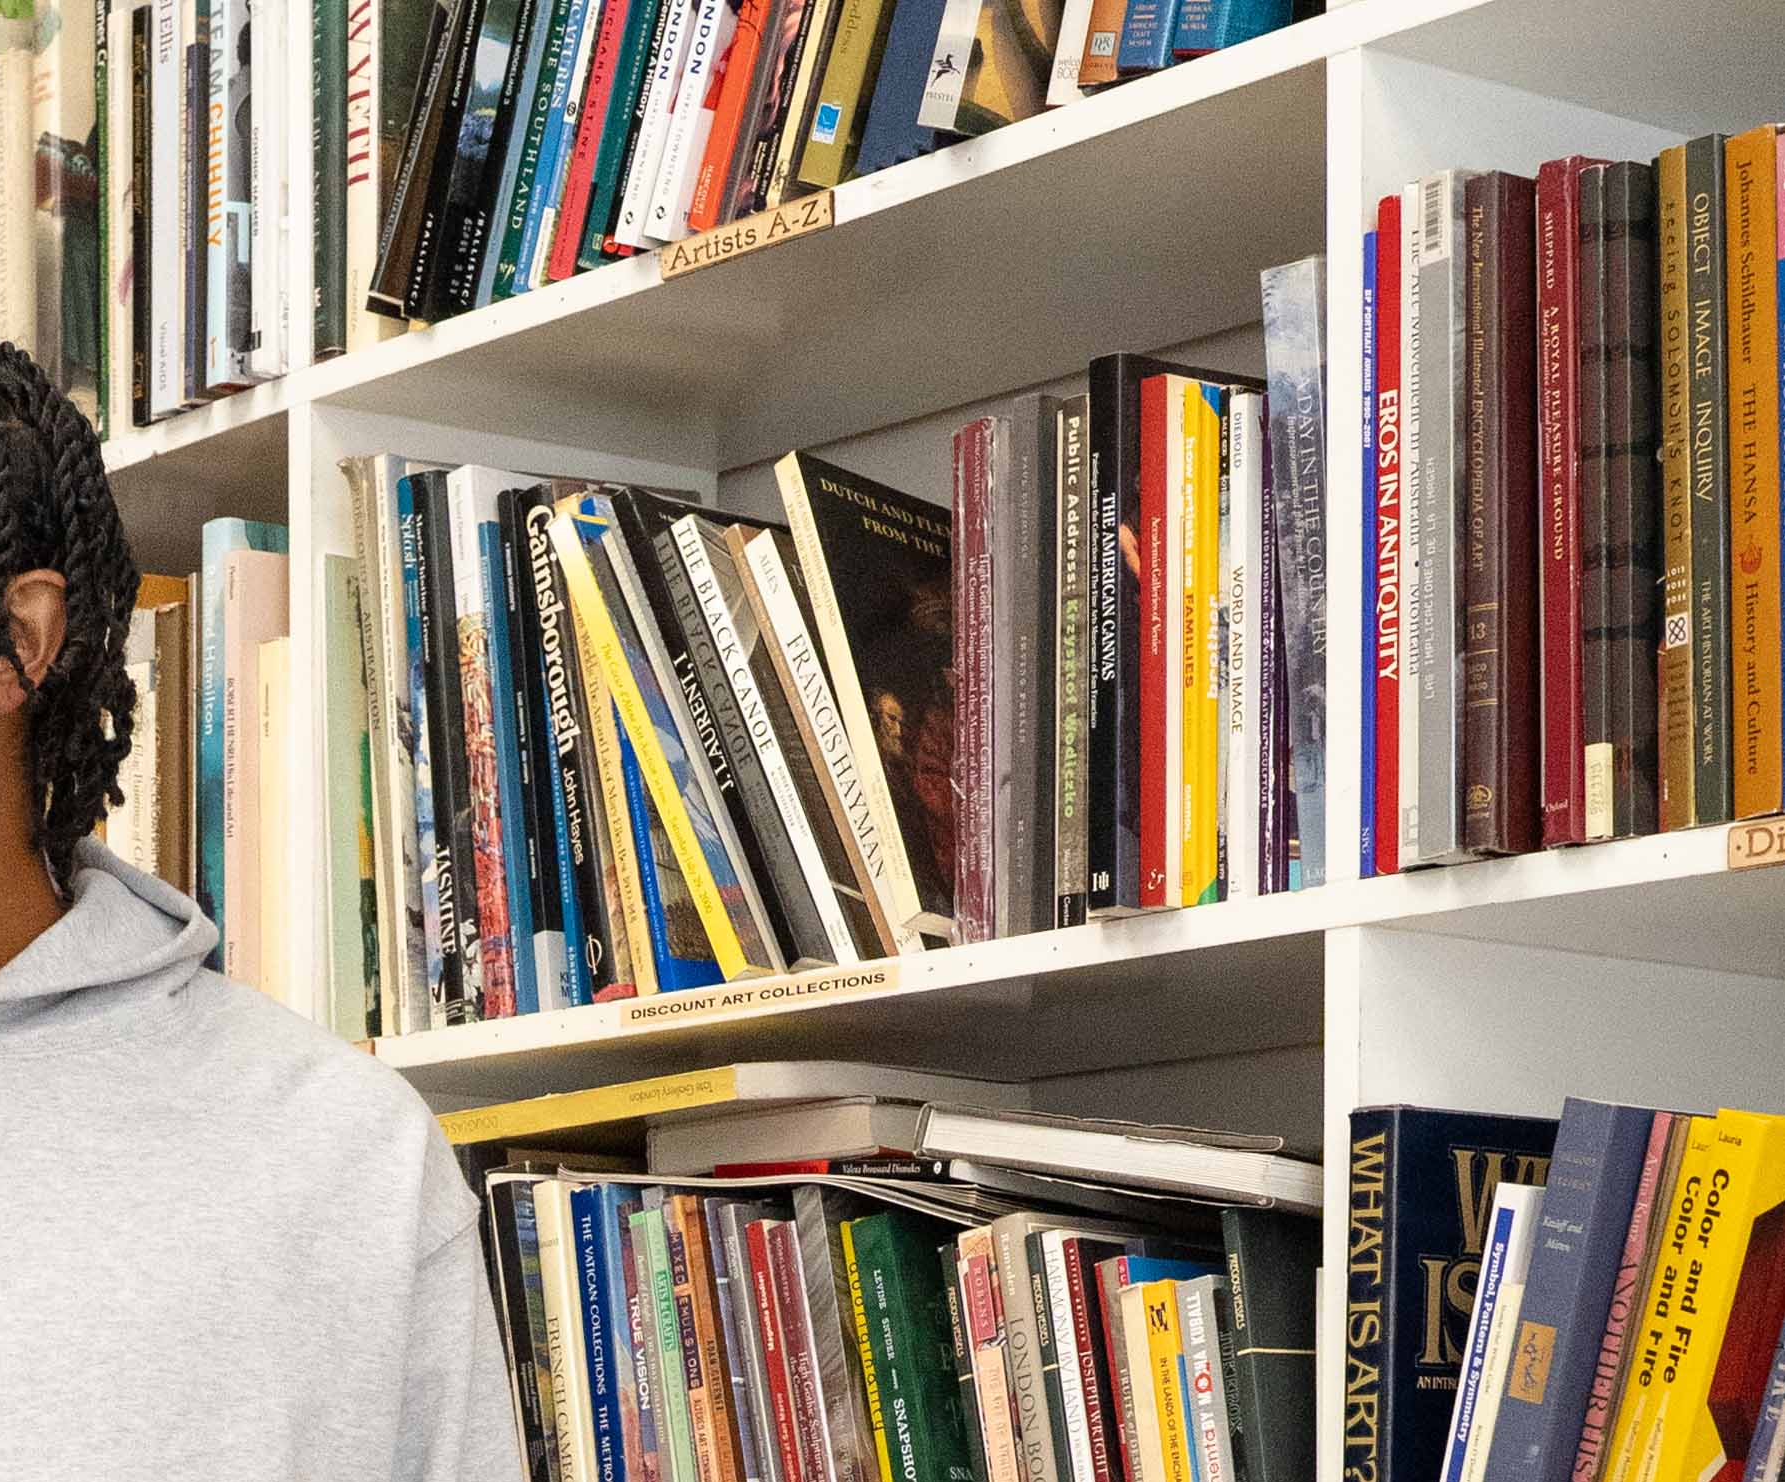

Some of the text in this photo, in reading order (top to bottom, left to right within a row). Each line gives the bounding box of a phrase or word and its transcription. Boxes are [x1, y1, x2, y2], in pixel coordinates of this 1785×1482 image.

[348, 0, 370, 186] WYETH
[511, 18, 567, 229] THE SOUTHLAND
[668, 198, 821, 272] Artists A-Z
[1544, 211, 1555, 289] SHEPPARD
[1692, 192, 1714, 502] OBJECT IMAGE INQUIRY
[1735, 160, 1758, 525] Johannes Schildhauer THE HANSA
[820, 477, 879, 510] DUTCH
[1069, 415, 1081, 480] Public
[1233, 411, 1242, 469] DIEBOLD
[401, 513, 414, 568] Splash
[1067, 486, 1078, 593] Address:
[1378, 389, 1400, 681] EROS IN ANTIQUITY
[526, 504, 583, 865] Gainsborough John Hayes
[676, 522, 775, 756] THE BLACK CANOE
[1230, 566, 1244, 736] WORD AND IMAGE
[786, 632, 887, 881] FRANCIS HAYMAN
[1063, 712, 1076, 819] Wodiczko
[436, 844, 456, 954] JASMINE
[631, 972, 887, 1021] DISCOUNT ART COLLECTIONS
[1718, 1131, 1743, 1146] Lauria
[581, 1215, 592, 1244] THE
[1350, 1133, 1386, 1287] WHAT
[583, 1247, 598, 1301] VATICAN
[1348, 1297, 1378, 1355] IS
[1661, 1168, 1730, 1387] Color and Fire
[547, 1316, 565, 1415] FRENCH
[588, 1302, 606, 1396] COLLECTIONS
[628, 1297, 650, 1411] TRUE VISION
[1009, 1317, 1036, 1438] LONDON
[597, 1404, 610, 1431] THE
